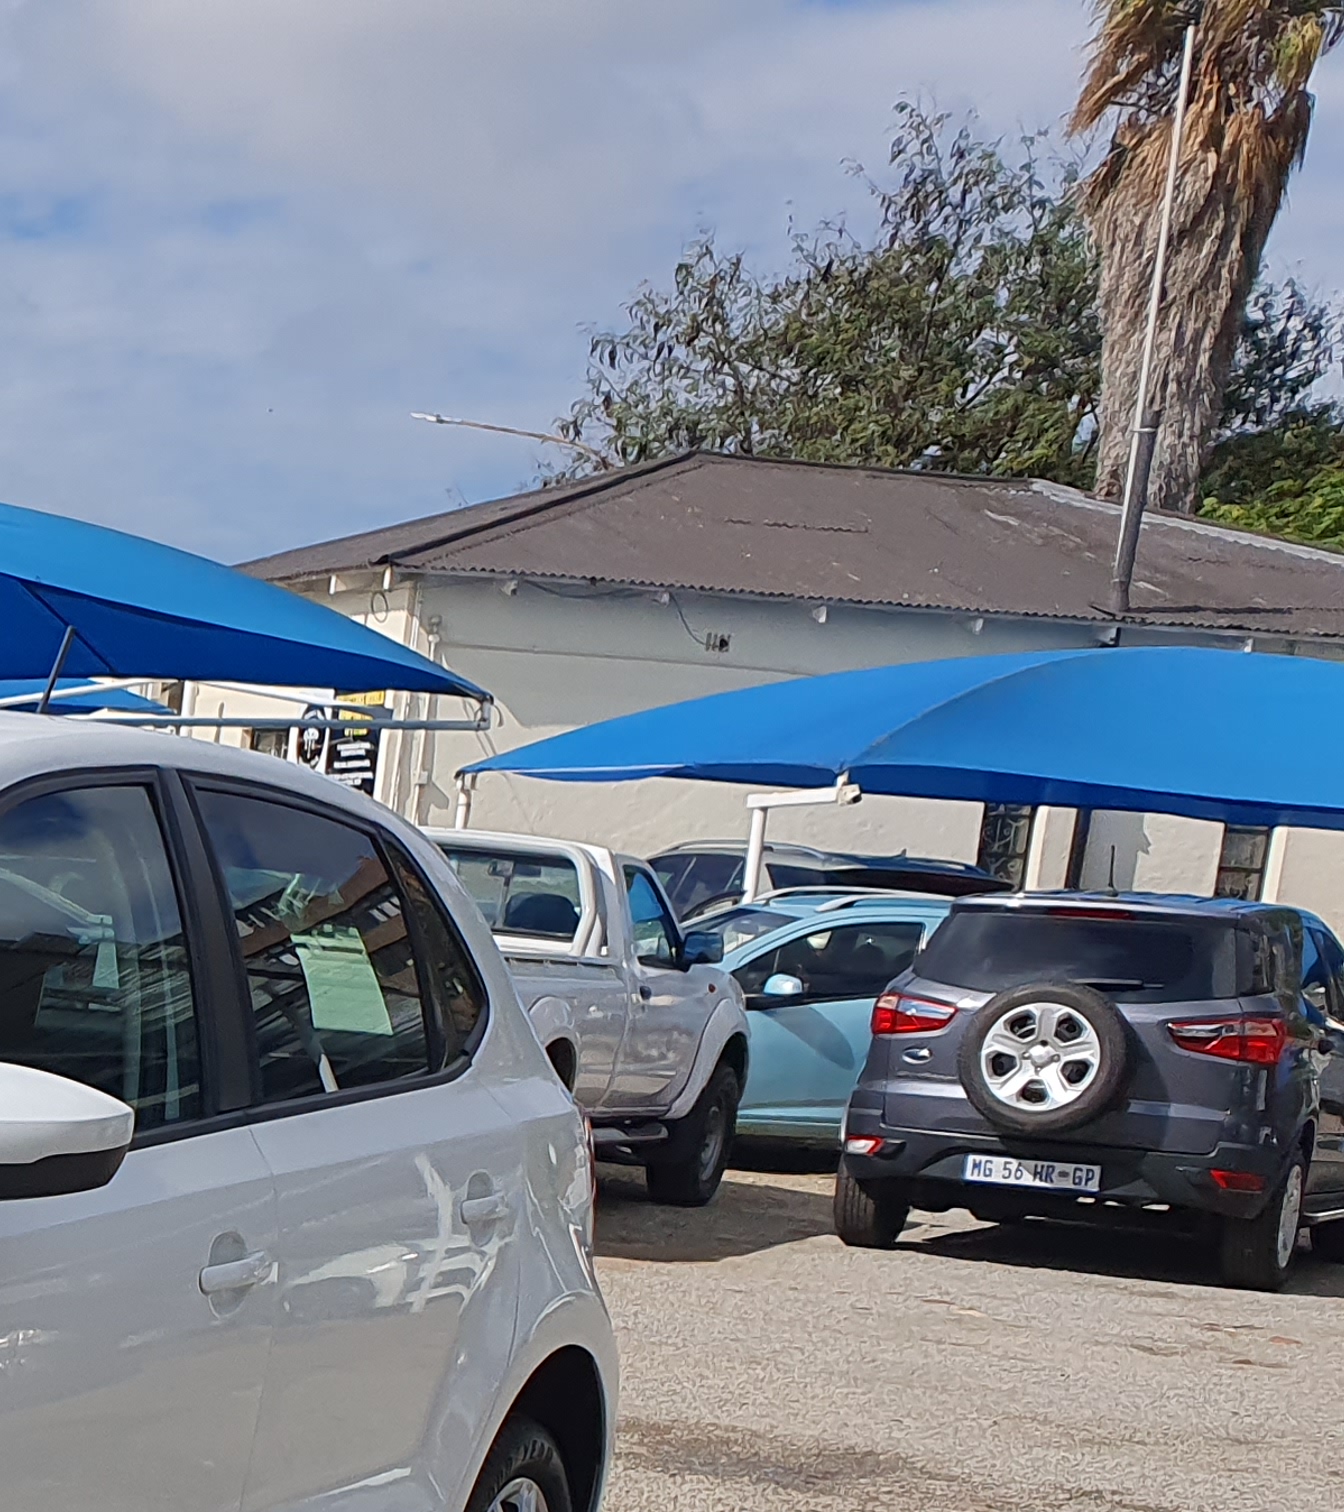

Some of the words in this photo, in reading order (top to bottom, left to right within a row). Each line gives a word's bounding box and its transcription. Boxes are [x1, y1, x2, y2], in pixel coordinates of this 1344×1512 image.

[970, 1158, 994, 1178] MG
[1001, 1159, 1024, 1180] 56
[1032, 1163, 1056, 1183] HR
[1071, 1167, 1096, 1187] GP
